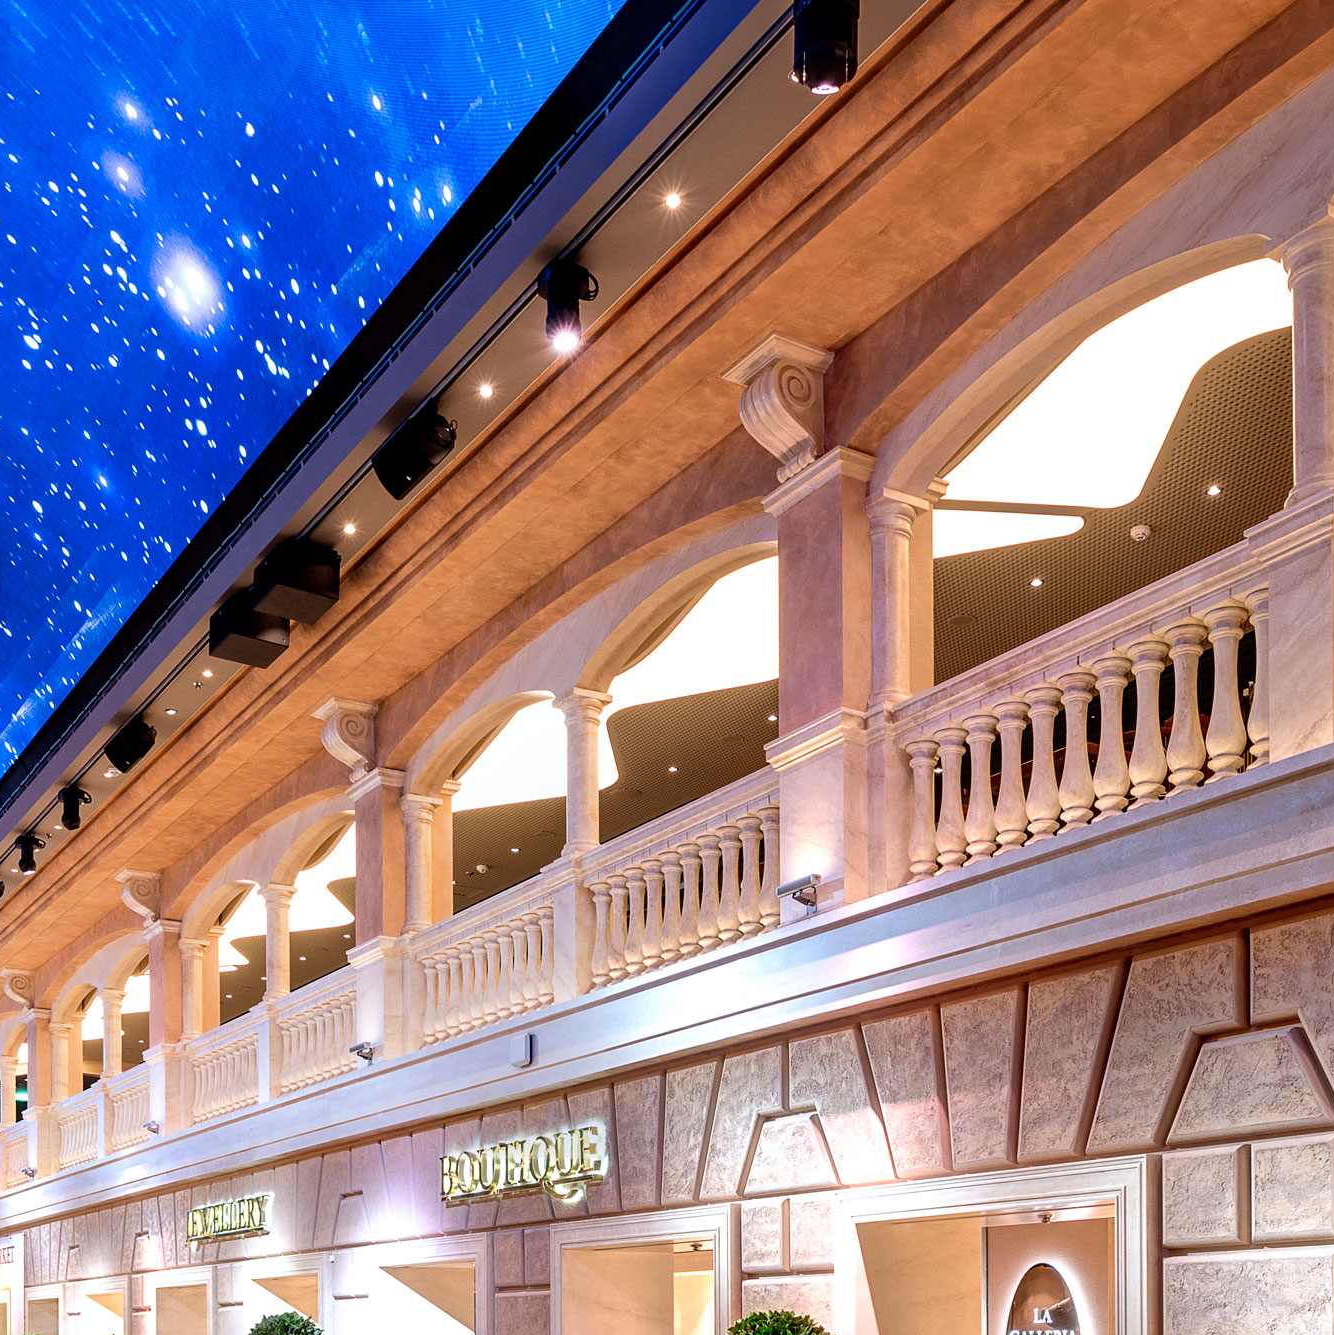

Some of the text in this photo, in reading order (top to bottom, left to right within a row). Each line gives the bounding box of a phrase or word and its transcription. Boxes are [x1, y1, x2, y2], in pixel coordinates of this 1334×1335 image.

[439, 1126, 600, 1199] BOUTIQUE
[185, 1195, 270, 1241] JEWELLERY
[1032, 1307, 1053, 1324] LA
